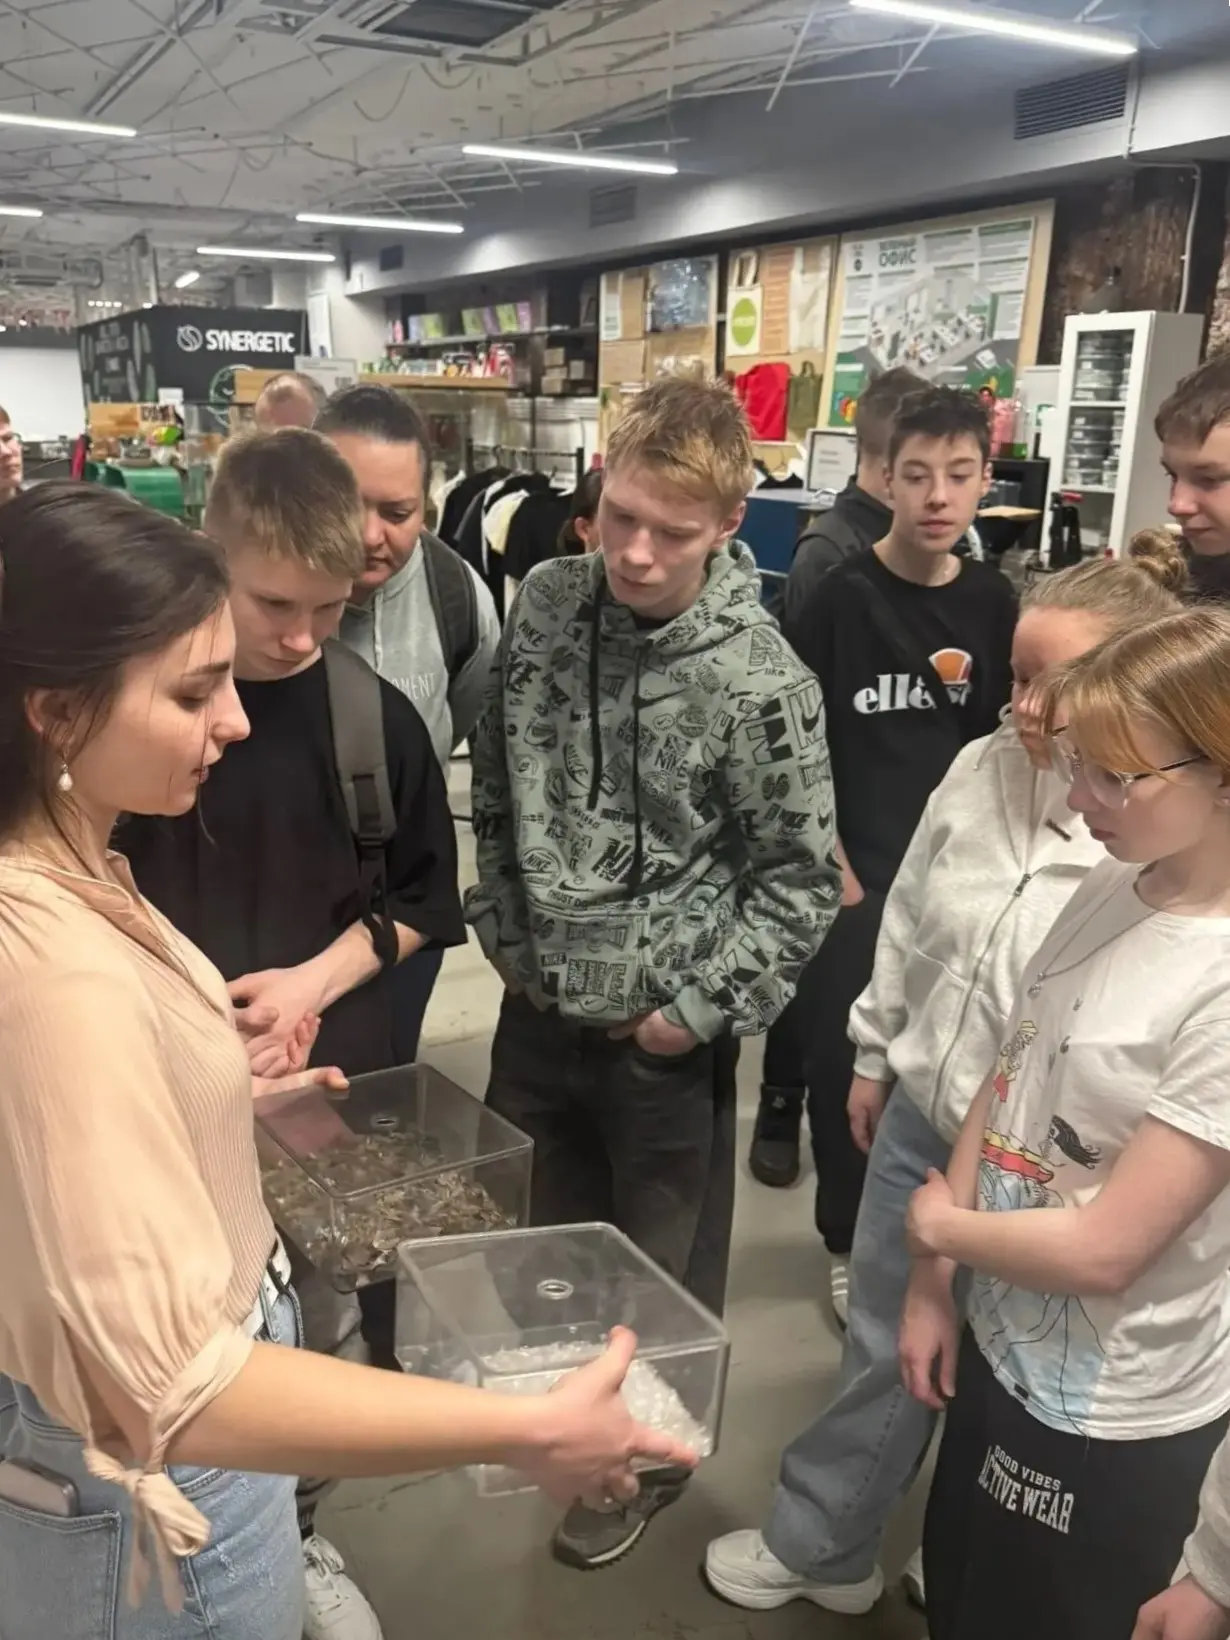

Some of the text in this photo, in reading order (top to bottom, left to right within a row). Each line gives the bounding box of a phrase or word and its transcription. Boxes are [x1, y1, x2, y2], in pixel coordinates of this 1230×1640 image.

[205, 330, 296, 353] SYNERGETIC
[993, 1444, 1062, 1492] GOOD VIBES
[1021, 1486, 1075, 1535] WEAR
